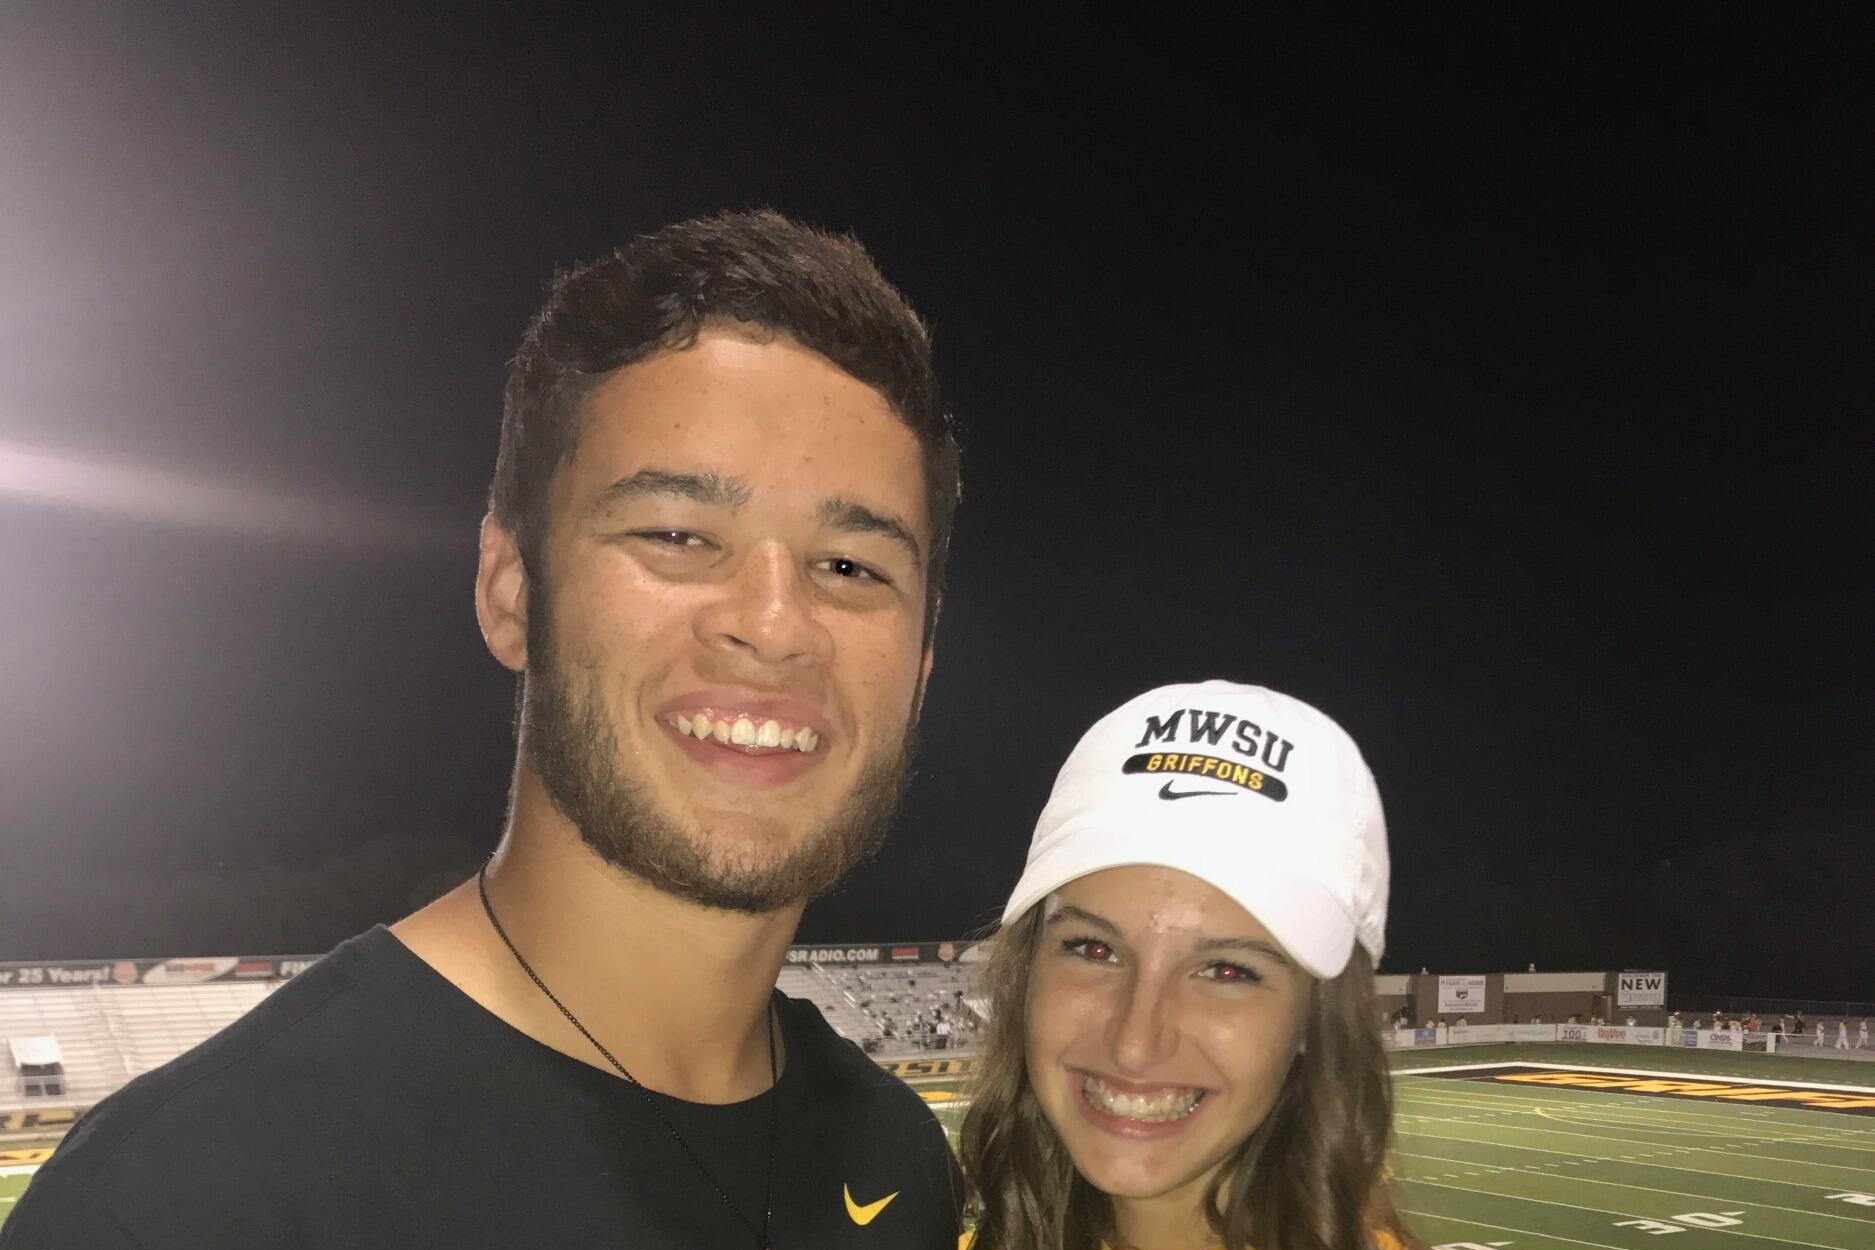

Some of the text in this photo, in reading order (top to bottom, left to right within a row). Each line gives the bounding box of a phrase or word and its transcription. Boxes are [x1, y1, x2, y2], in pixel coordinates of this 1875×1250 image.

[1135, 709, 1294, 772] MWSU
[1147, 754, 1264, 790] GRIFFONS
[785, 949, 879, 962] SRADIO.COM
[18, 967, 43, 983] 25
[1621, 978, 1661, 990] NEW
[1612, 1212, 1744, 1235] 30
